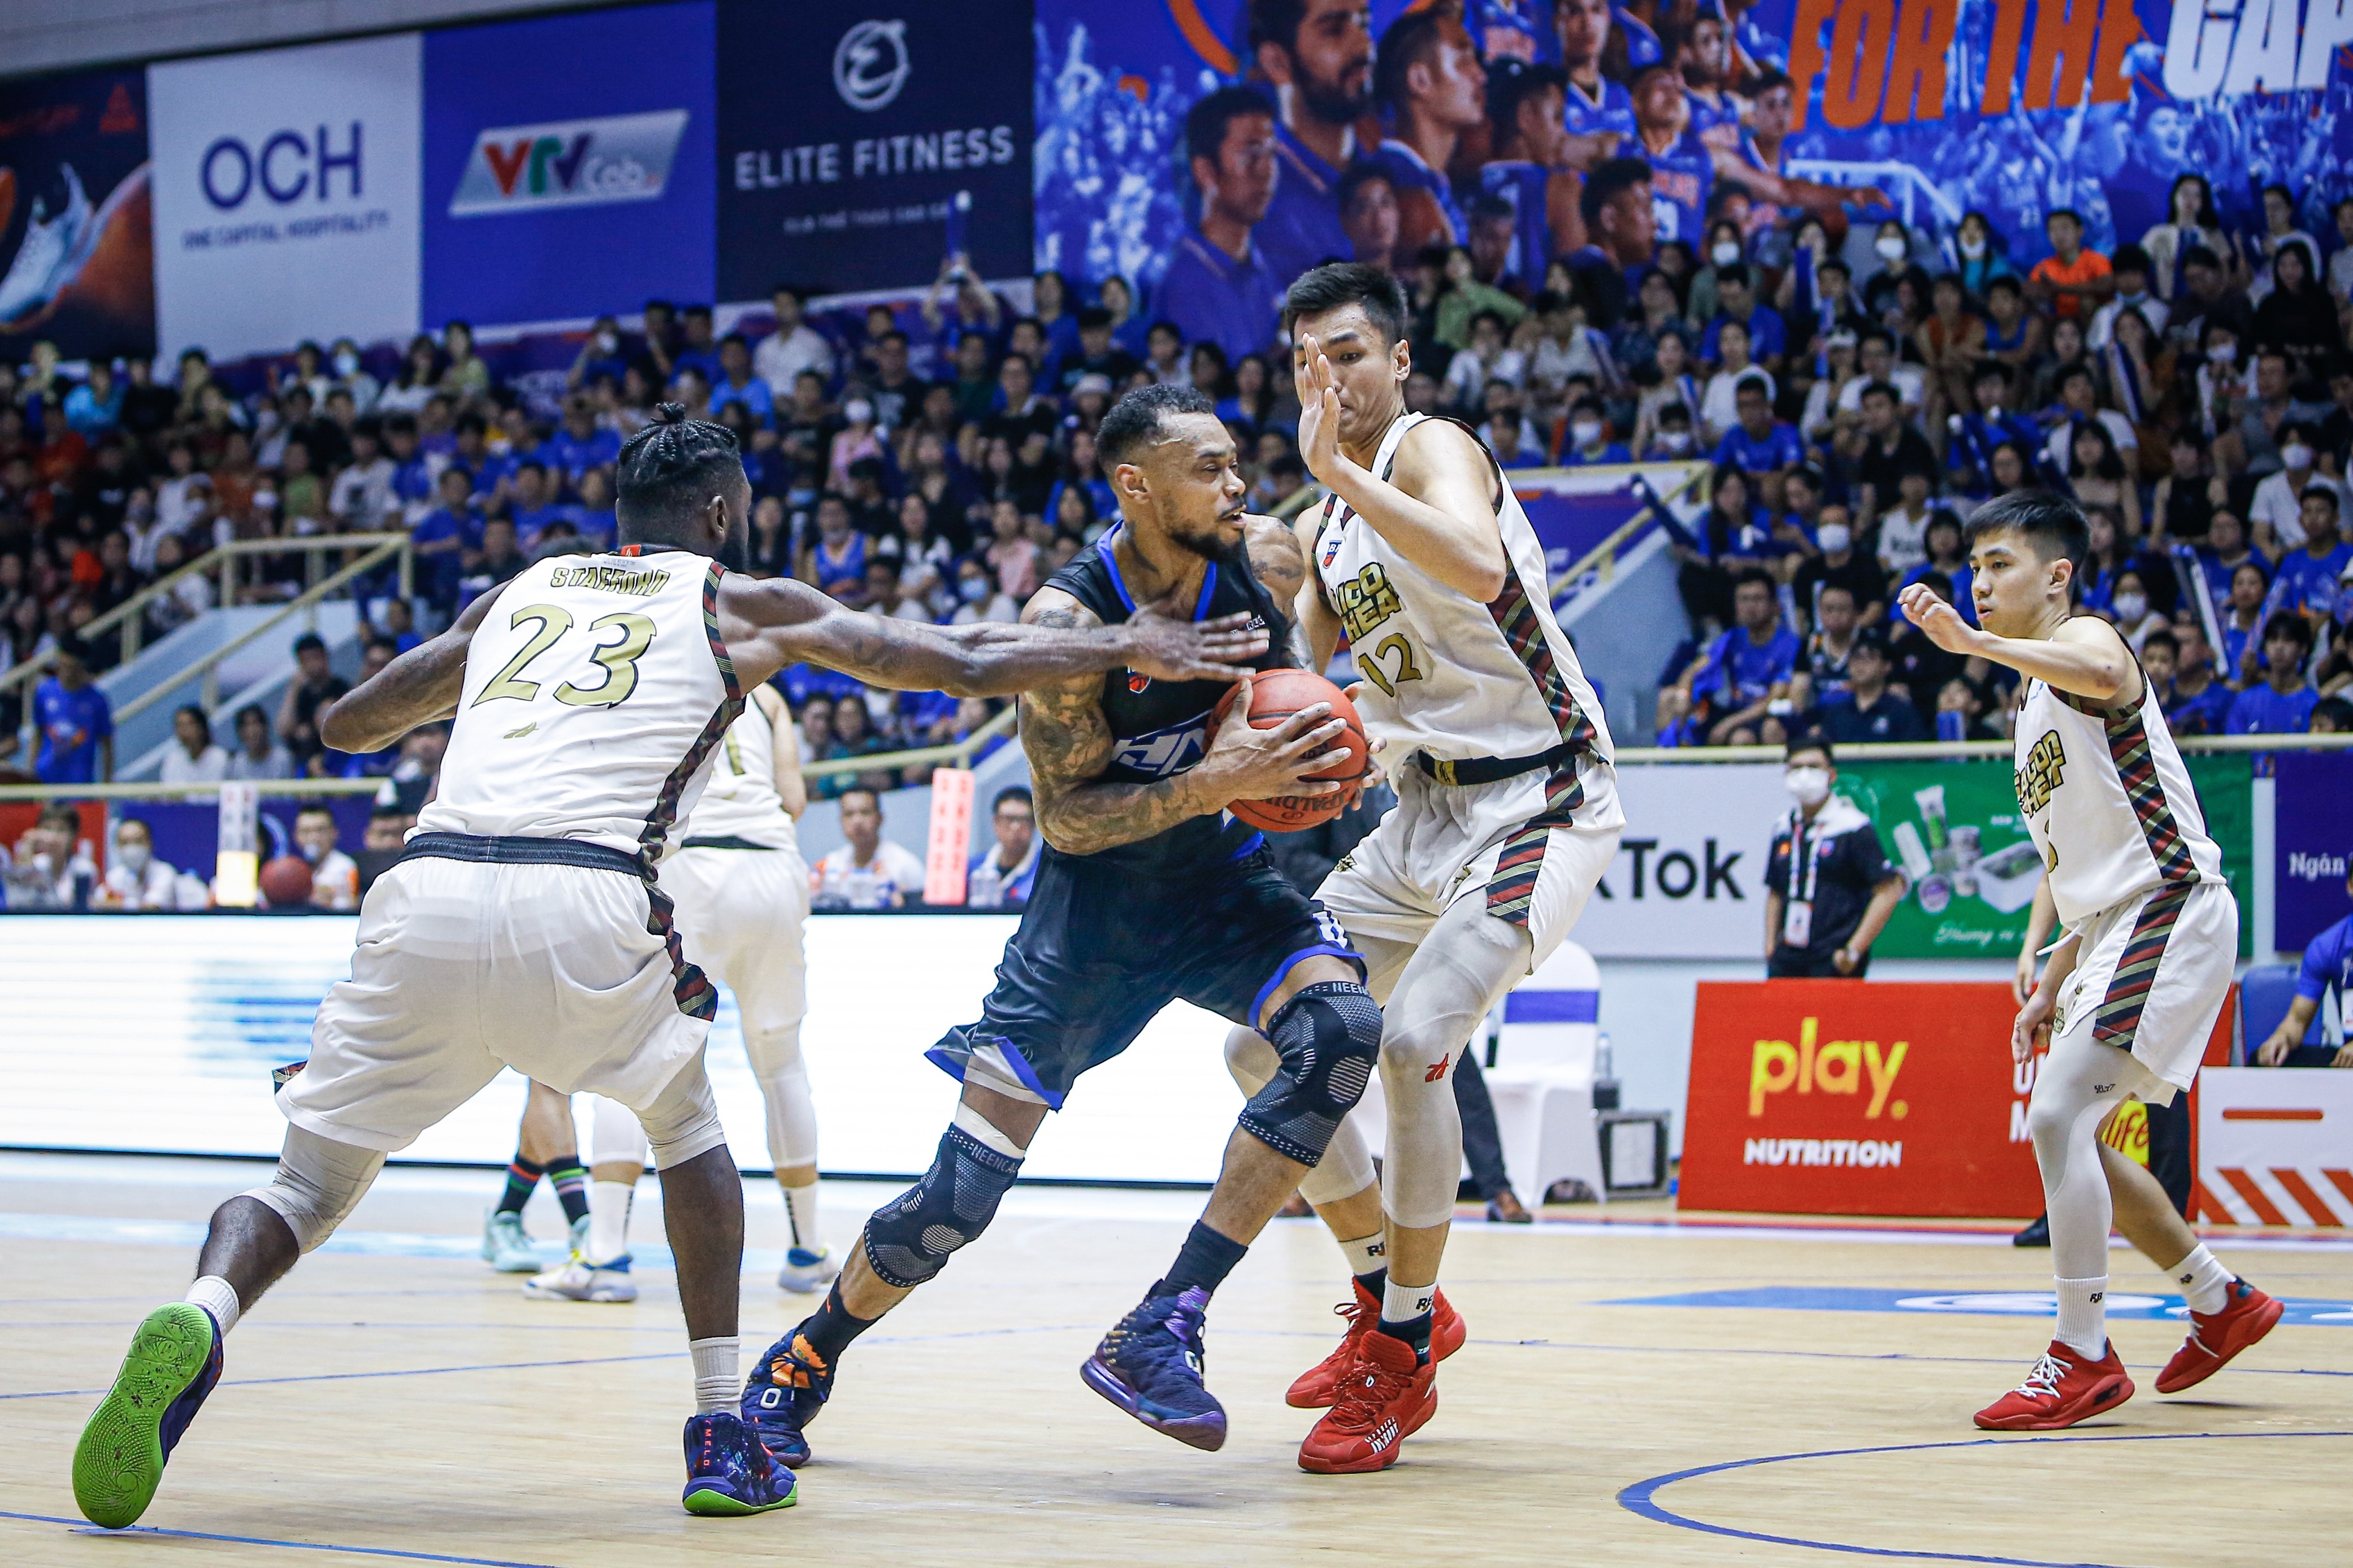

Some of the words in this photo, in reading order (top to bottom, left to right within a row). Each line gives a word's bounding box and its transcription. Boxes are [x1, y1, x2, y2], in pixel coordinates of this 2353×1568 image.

[1786, 0, 1960, 130] FOR
[1980, 0, 2143, 114] THE
[201, 120, 363, 210] OCH
[735, 143, 840, 190] ELITE
[853, 125, 1015, 177] FITNESS
[551, 567, 671, 597] STAFFORD
[470, 603, 657, 709] 23
[1358, 632, 1423, 698] 12
[1596, 838, 1745, 900] Tok
[1744, 1138, 1903, 1167] NUTRITION
